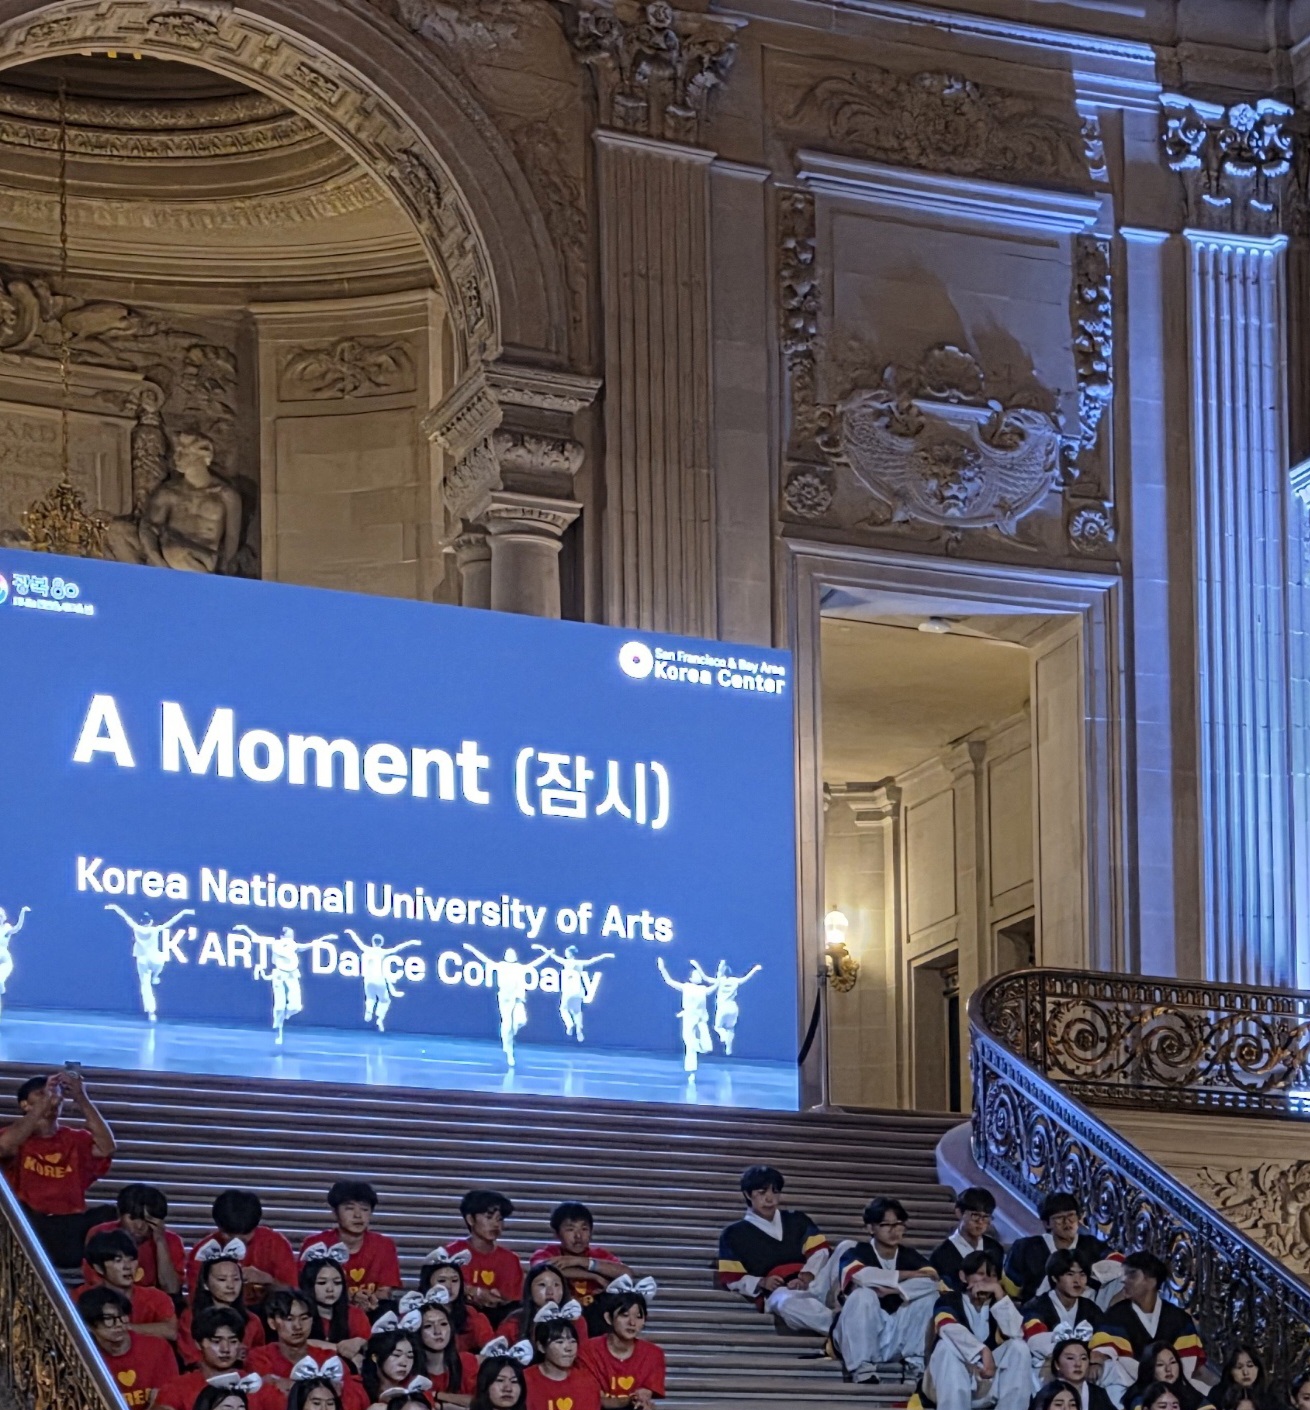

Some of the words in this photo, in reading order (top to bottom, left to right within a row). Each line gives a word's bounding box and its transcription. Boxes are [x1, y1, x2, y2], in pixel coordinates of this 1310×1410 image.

[654, 648, 676, 661] San
[677, 650, 726, 667] Francisco
[654, 660, 712, 685] Korea
[717, 669, 786, 694] Center
[73, 694, 135, 768] A
[160, 700, 491, 805] Moment
[514, 746, 671, 830] (잠시)
[77, 856, 189, 900] Korea
[201, 867, 354, 915] National
[366, 882, 547, 938] University
[556, 902, 593, 935] of
[601, 904, 674, 942] Arts
